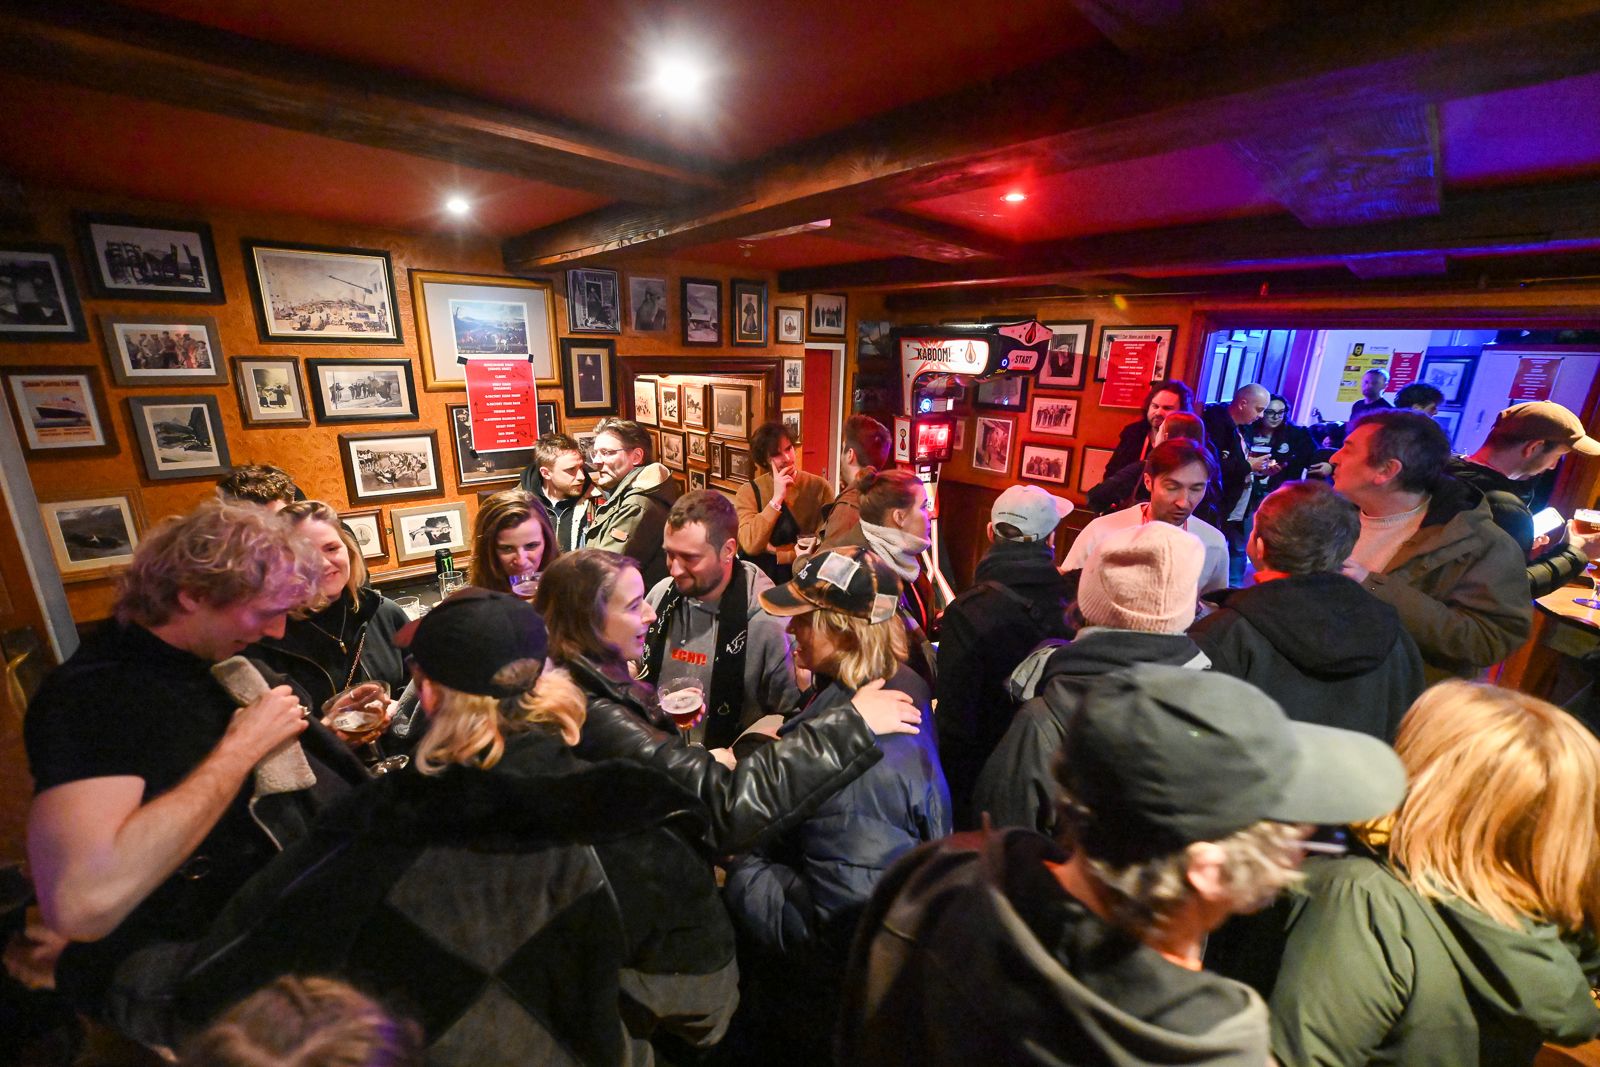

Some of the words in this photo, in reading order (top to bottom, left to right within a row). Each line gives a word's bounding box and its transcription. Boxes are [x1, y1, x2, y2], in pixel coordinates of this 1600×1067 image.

[917, 347, 951, 362] KABOOM!
[1014, 355, 1032, 364] START
[672, 648, 707, 666] ECHT!
